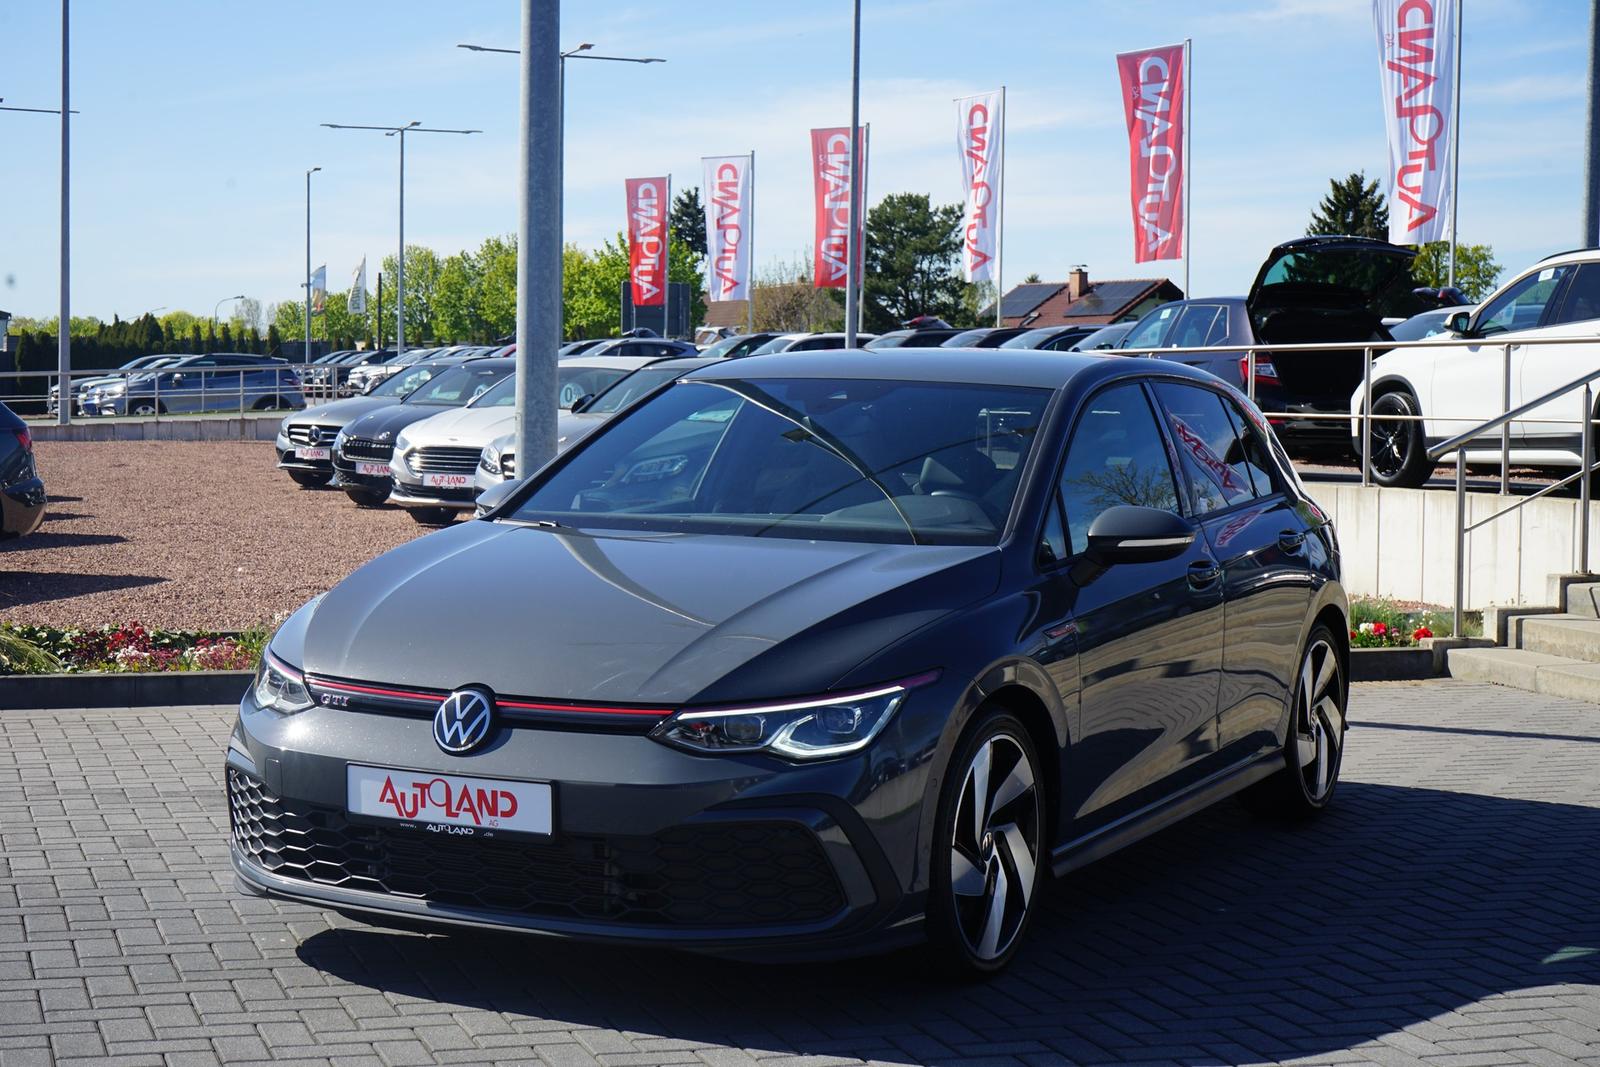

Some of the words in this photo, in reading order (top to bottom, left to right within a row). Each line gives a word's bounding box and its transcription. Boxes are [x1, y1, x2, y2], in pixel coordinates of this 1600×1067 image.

[320, 693, 351, 706] GTI
[379, 775, 518, 825] AUTOLAND
[426, 823, 474, 835] AUTOLAND
